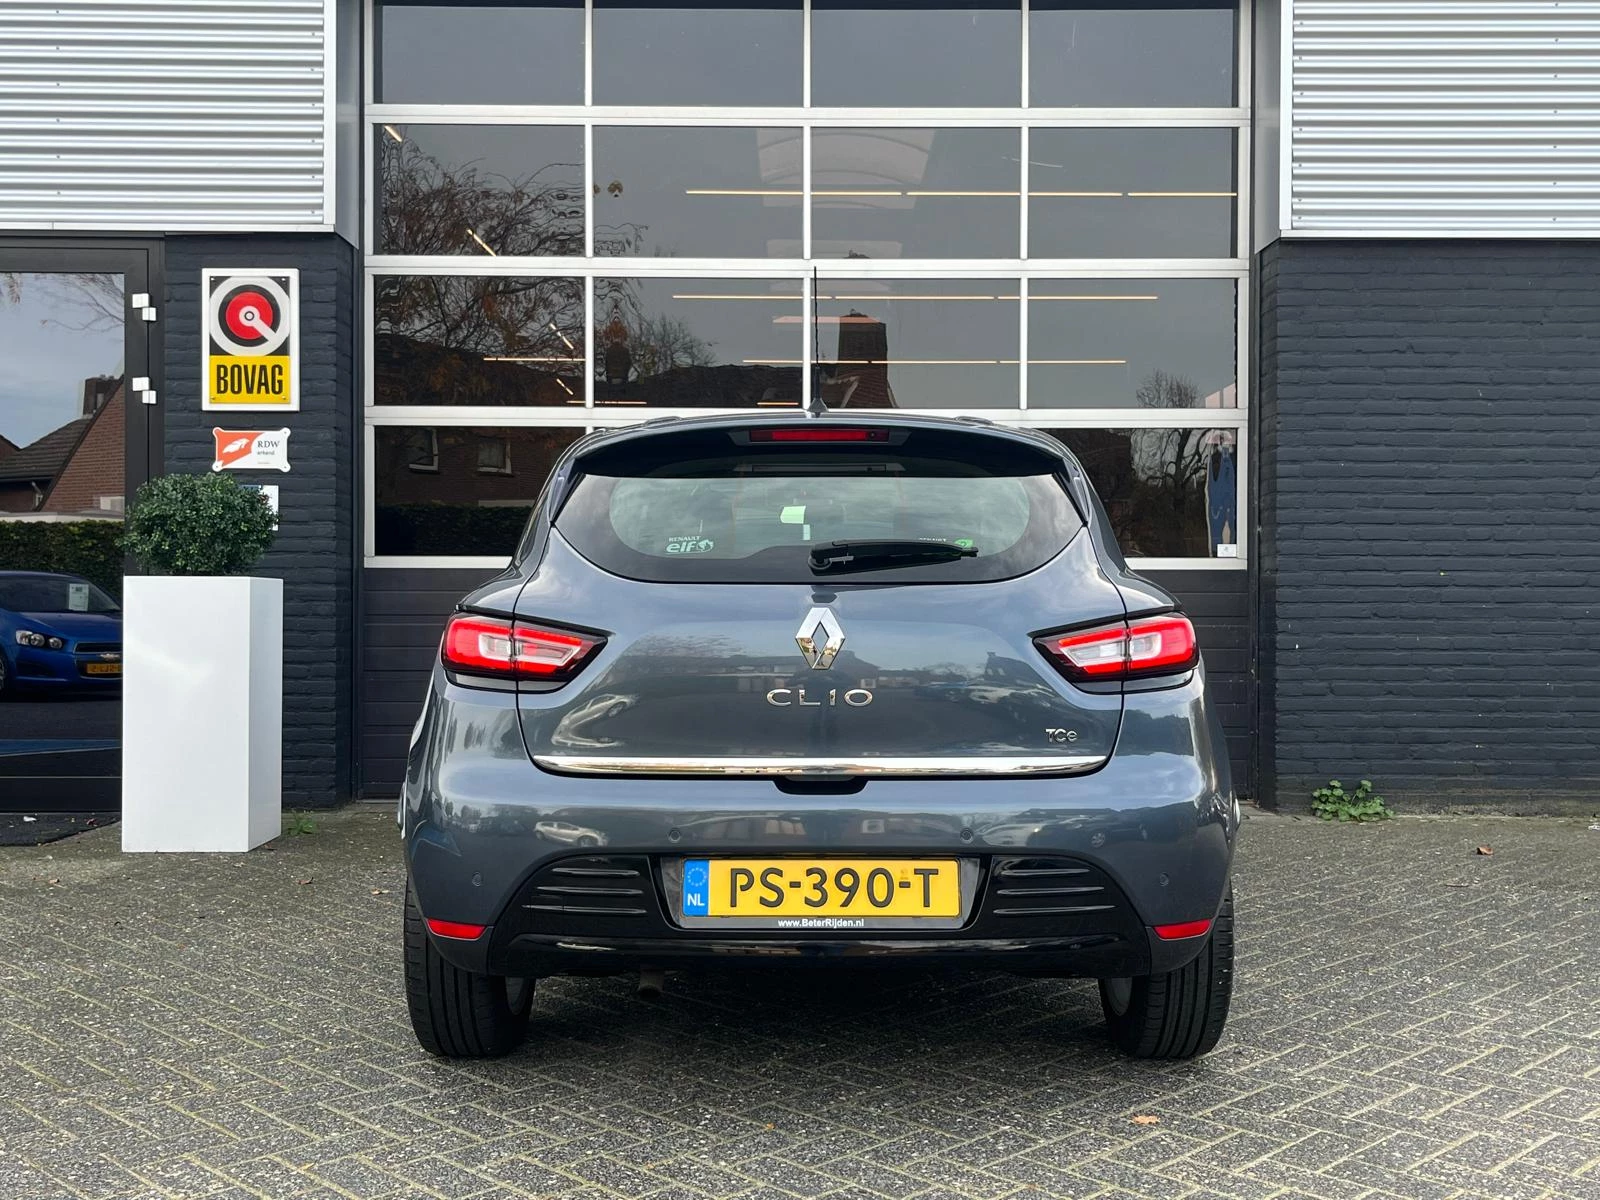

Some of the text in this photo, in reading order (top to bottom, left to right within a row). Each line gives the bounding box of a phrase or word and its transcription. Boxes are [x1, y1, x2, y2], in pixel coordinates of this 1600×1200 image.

[216, 364, 284, 395] BOVAG
[257, 440, 280, 448] RDW
[666, 541, 697, 553] elf
[766, 688, 873, 707] CLIO
[1045, 728, 1077, 743] TCe
[730, 867, 939, 908] PS-390-T
[687, 894, 704, 906] NL
[777, 918, 865, 929] www.BeterRijden.nl
